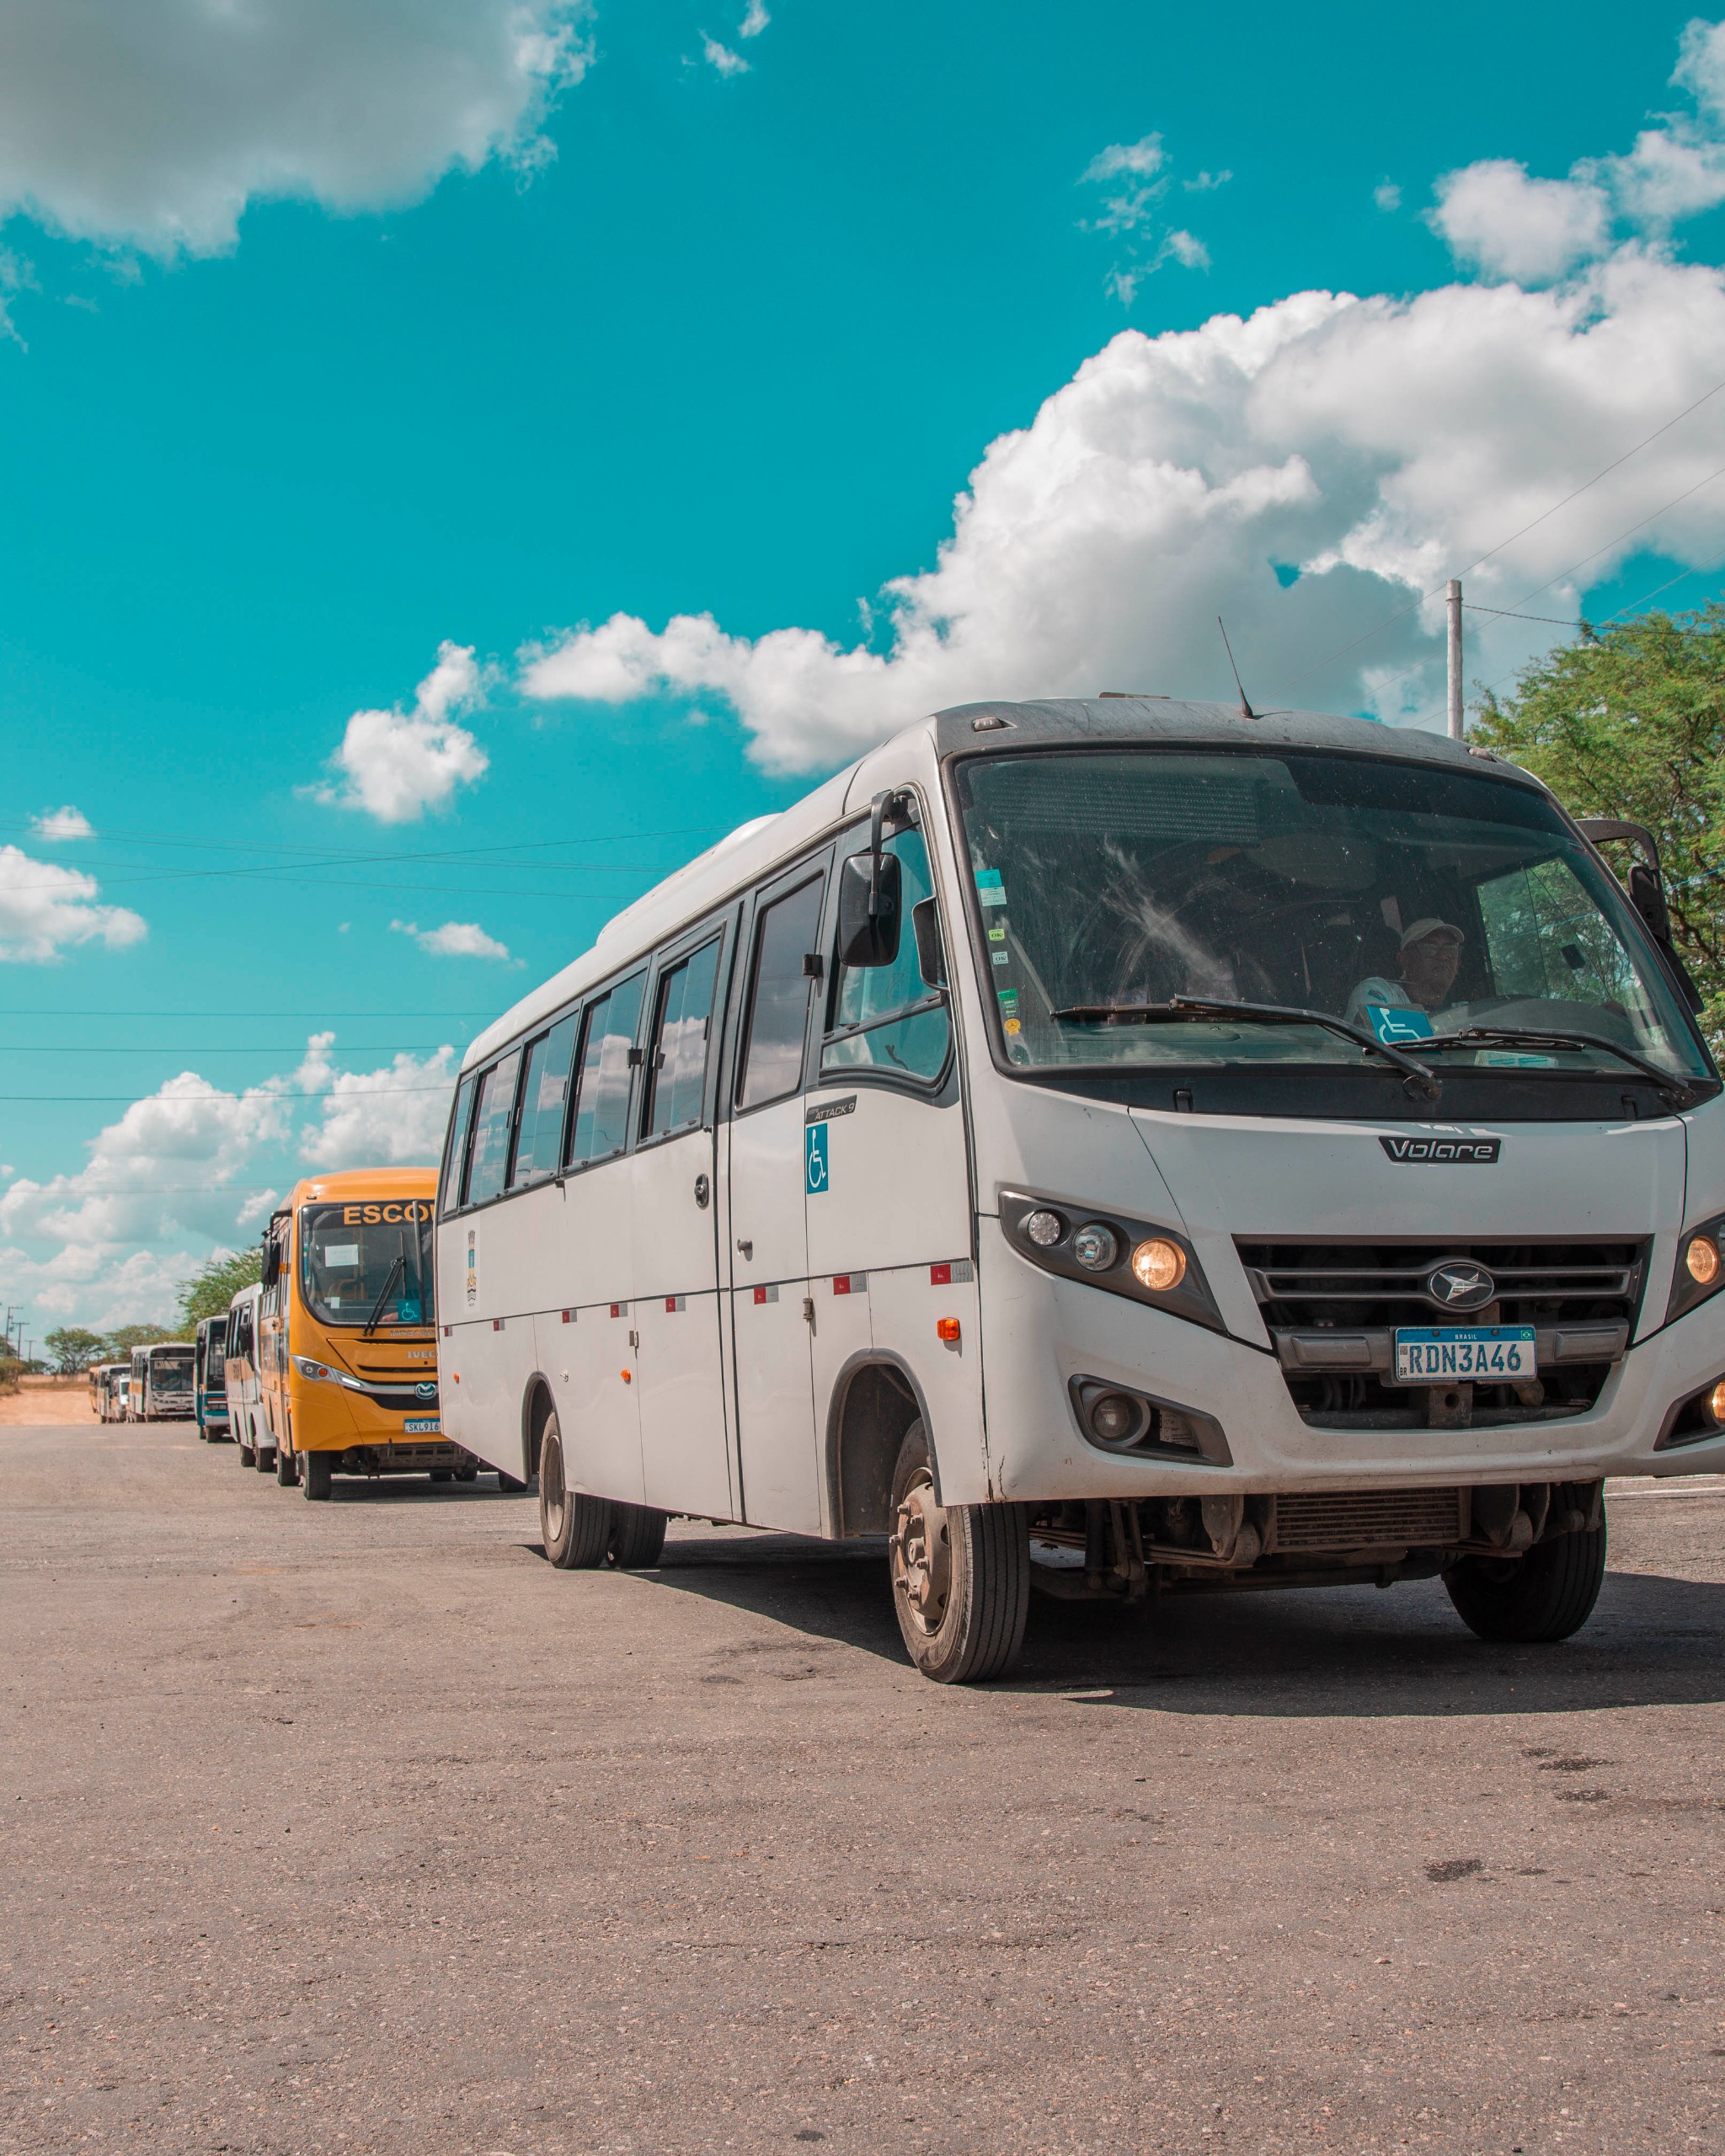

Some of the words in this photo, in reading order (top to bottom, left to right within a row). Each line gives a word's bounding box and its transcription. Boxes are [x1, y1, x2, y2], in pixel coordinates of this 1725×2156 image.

[814, 1104, 847, 1121] ATTACK
[848, 1102, 855, 1113] 9
[1389, 1139, 1493, 1159] Volare
[1409, 1343, 1521, 1374] RDN3A46
[1399, 1367, 1407, 1376] BR
